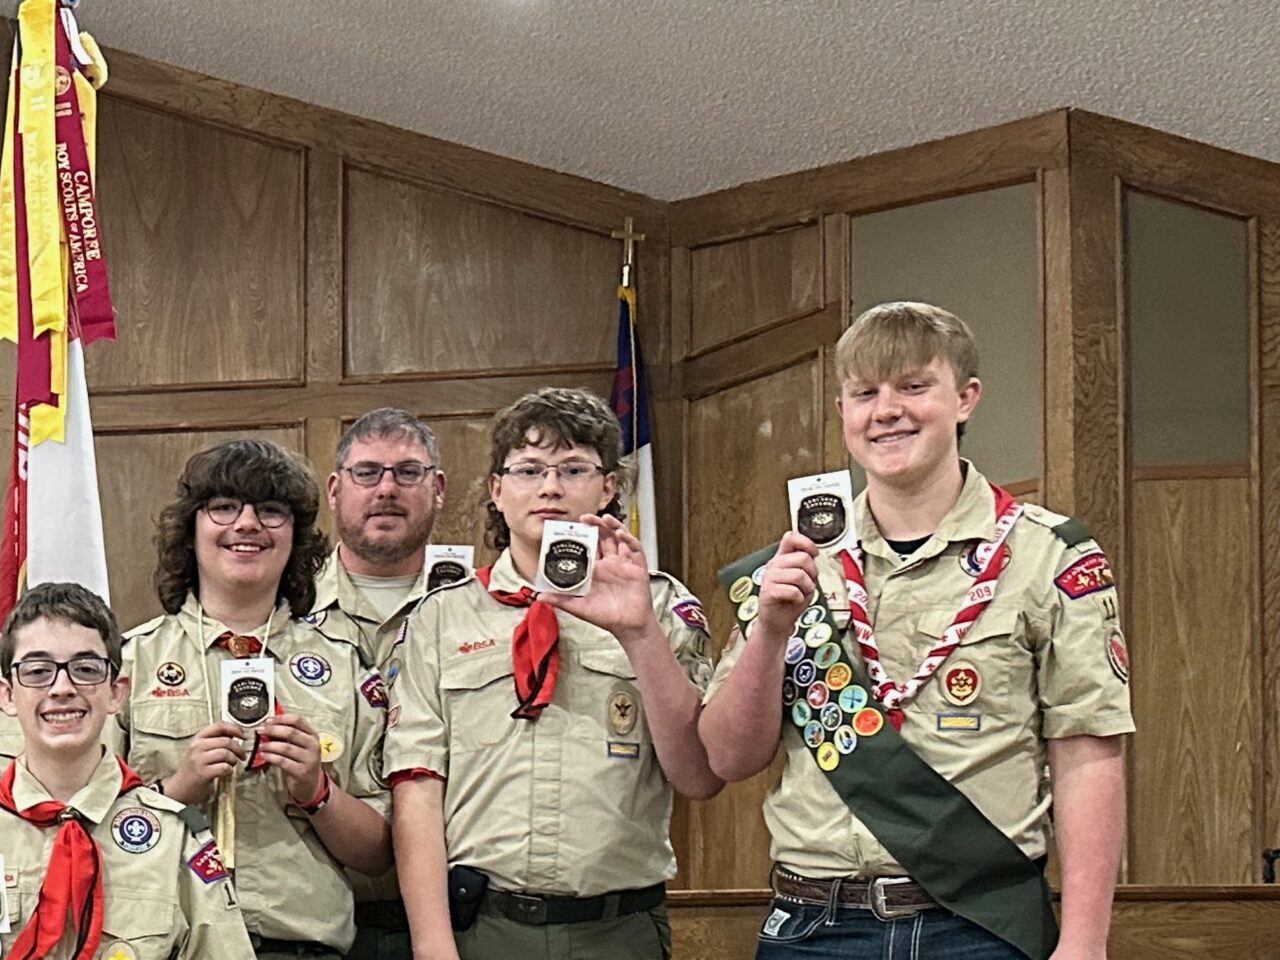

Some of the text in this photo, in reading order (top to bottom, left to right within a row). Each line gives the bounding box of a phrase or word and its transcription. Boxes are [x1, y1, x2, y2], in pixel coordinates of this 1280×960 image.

[56, 142, 71, 169] BOY
[60, 172, 79, 222] SCOUTS
[74, 170, 101, 261] CAMPOREE
[69, 233, 89, 293] AMERICA
[969, 586, 992, 601] 209
[167, 688, 191, 697] BSA
